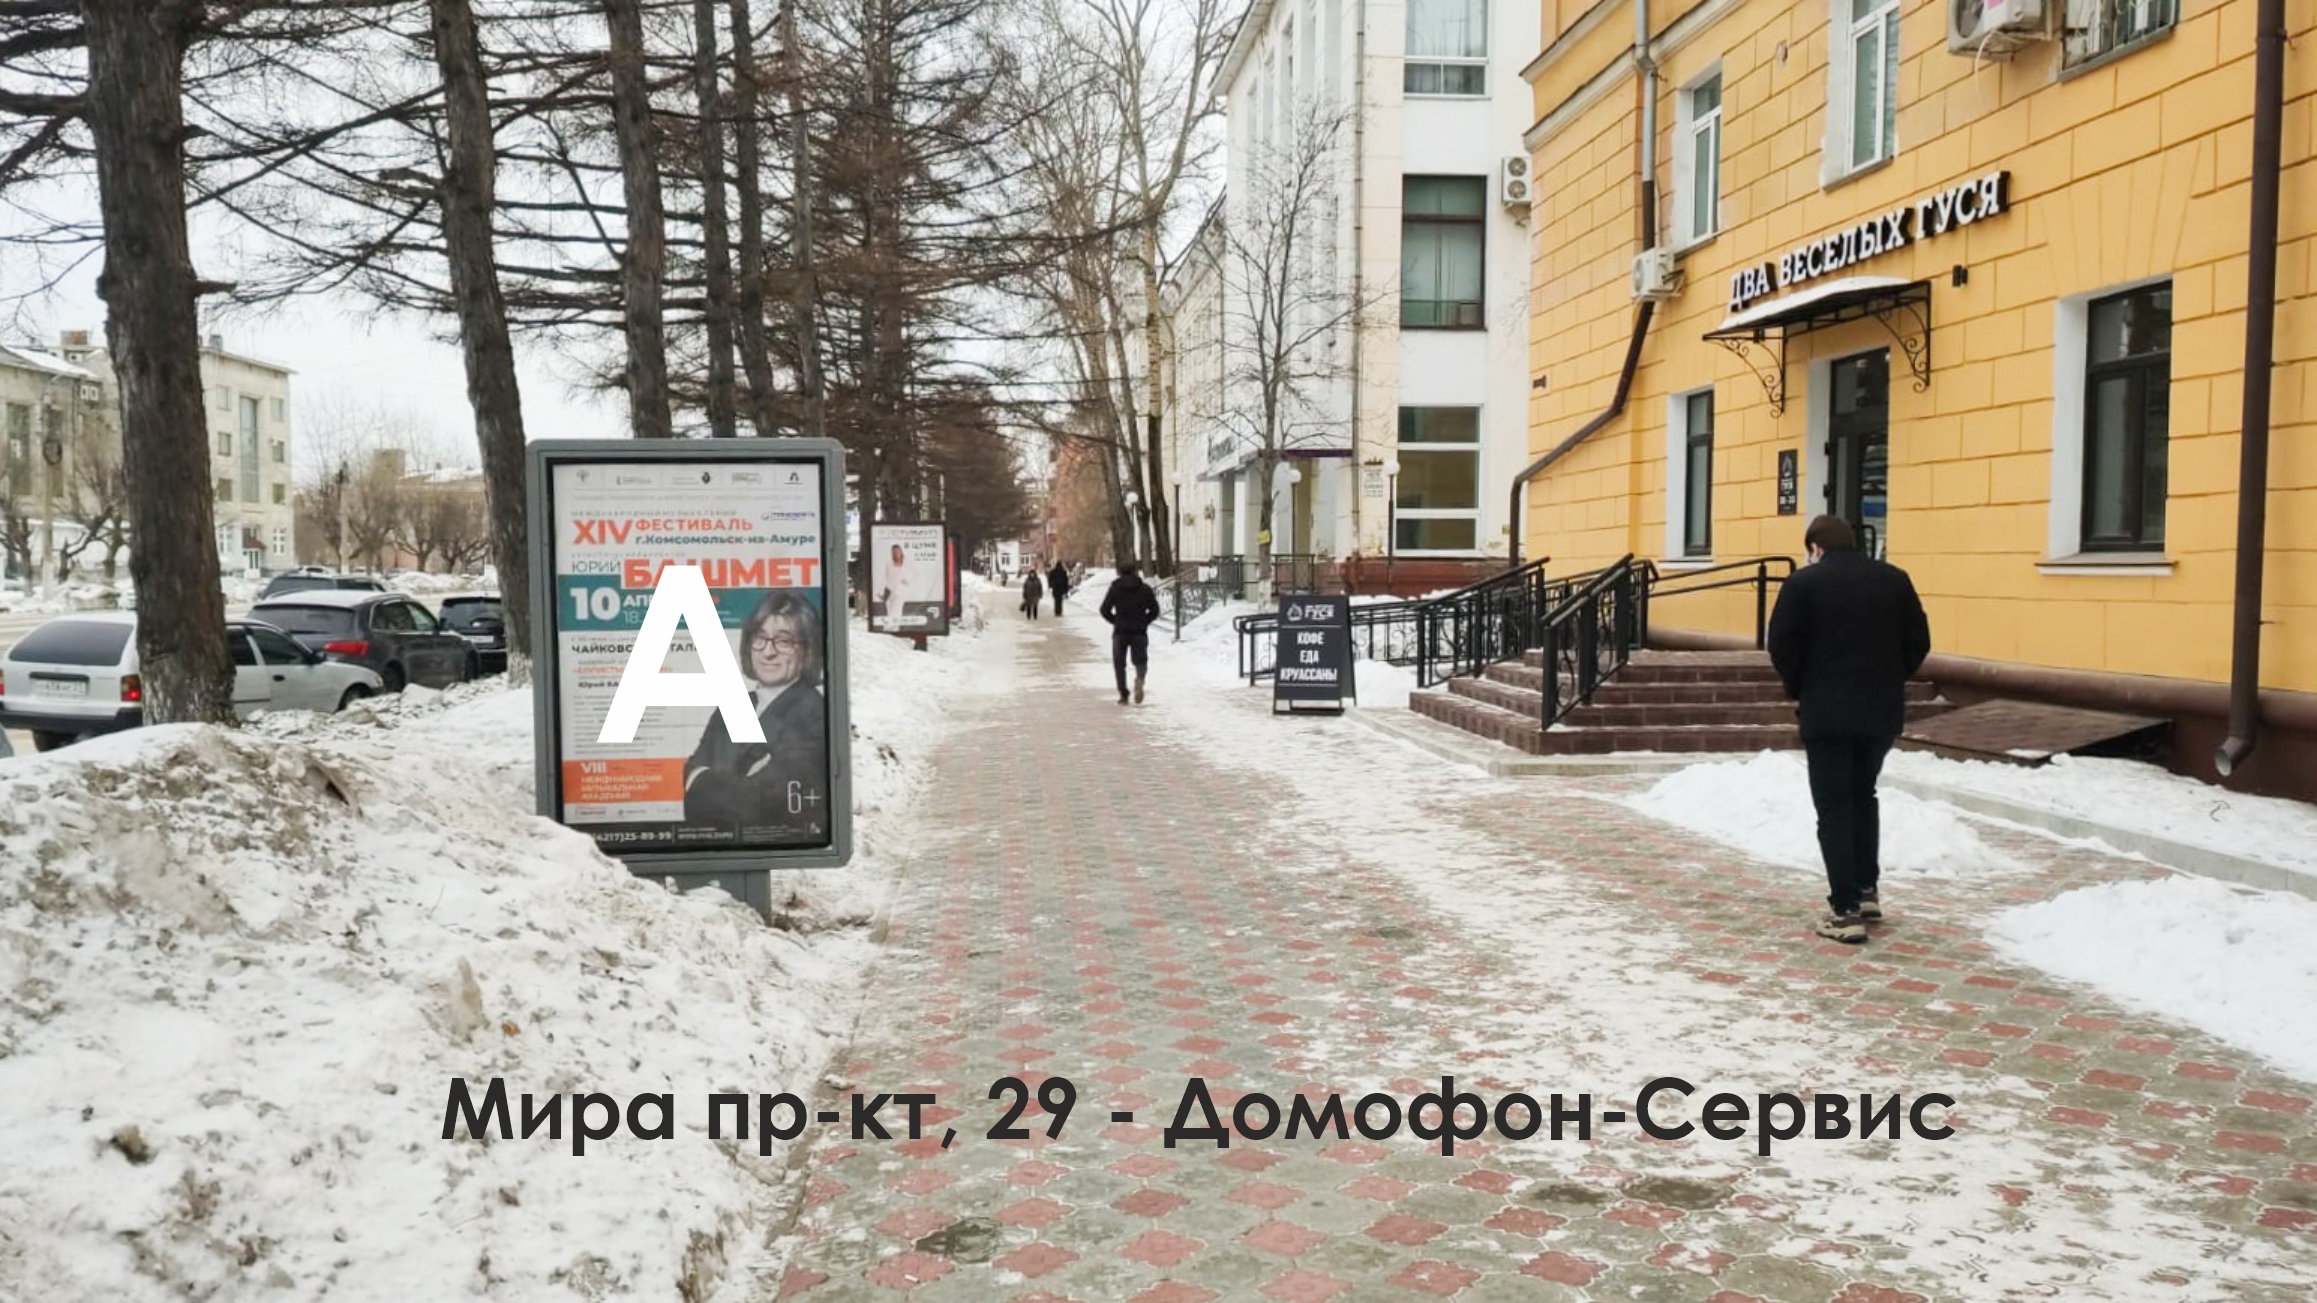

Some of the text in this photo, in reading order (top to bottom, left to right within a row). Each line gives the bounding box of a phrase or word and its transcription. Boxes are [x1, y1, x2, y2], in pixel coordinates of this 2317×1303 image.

[1729, 170, 2004, 311] ДВА ВЕСЕЛЫХ ГУСЯ
[572, 518, 633, 545] XIV
[634, 518, 754, 532] ФЕСТИВАЛЬ
[569, 586, 621, 621] 10
[1297, 631, 1325, 645] КОФЕ
[1300, 650, 1319, 664] ЕДА
[1280, 668, 1338, 681] КРУАССАНЫ
[581, 760, 606, 774] VIII
[787, 780, 821, 814] 6+
